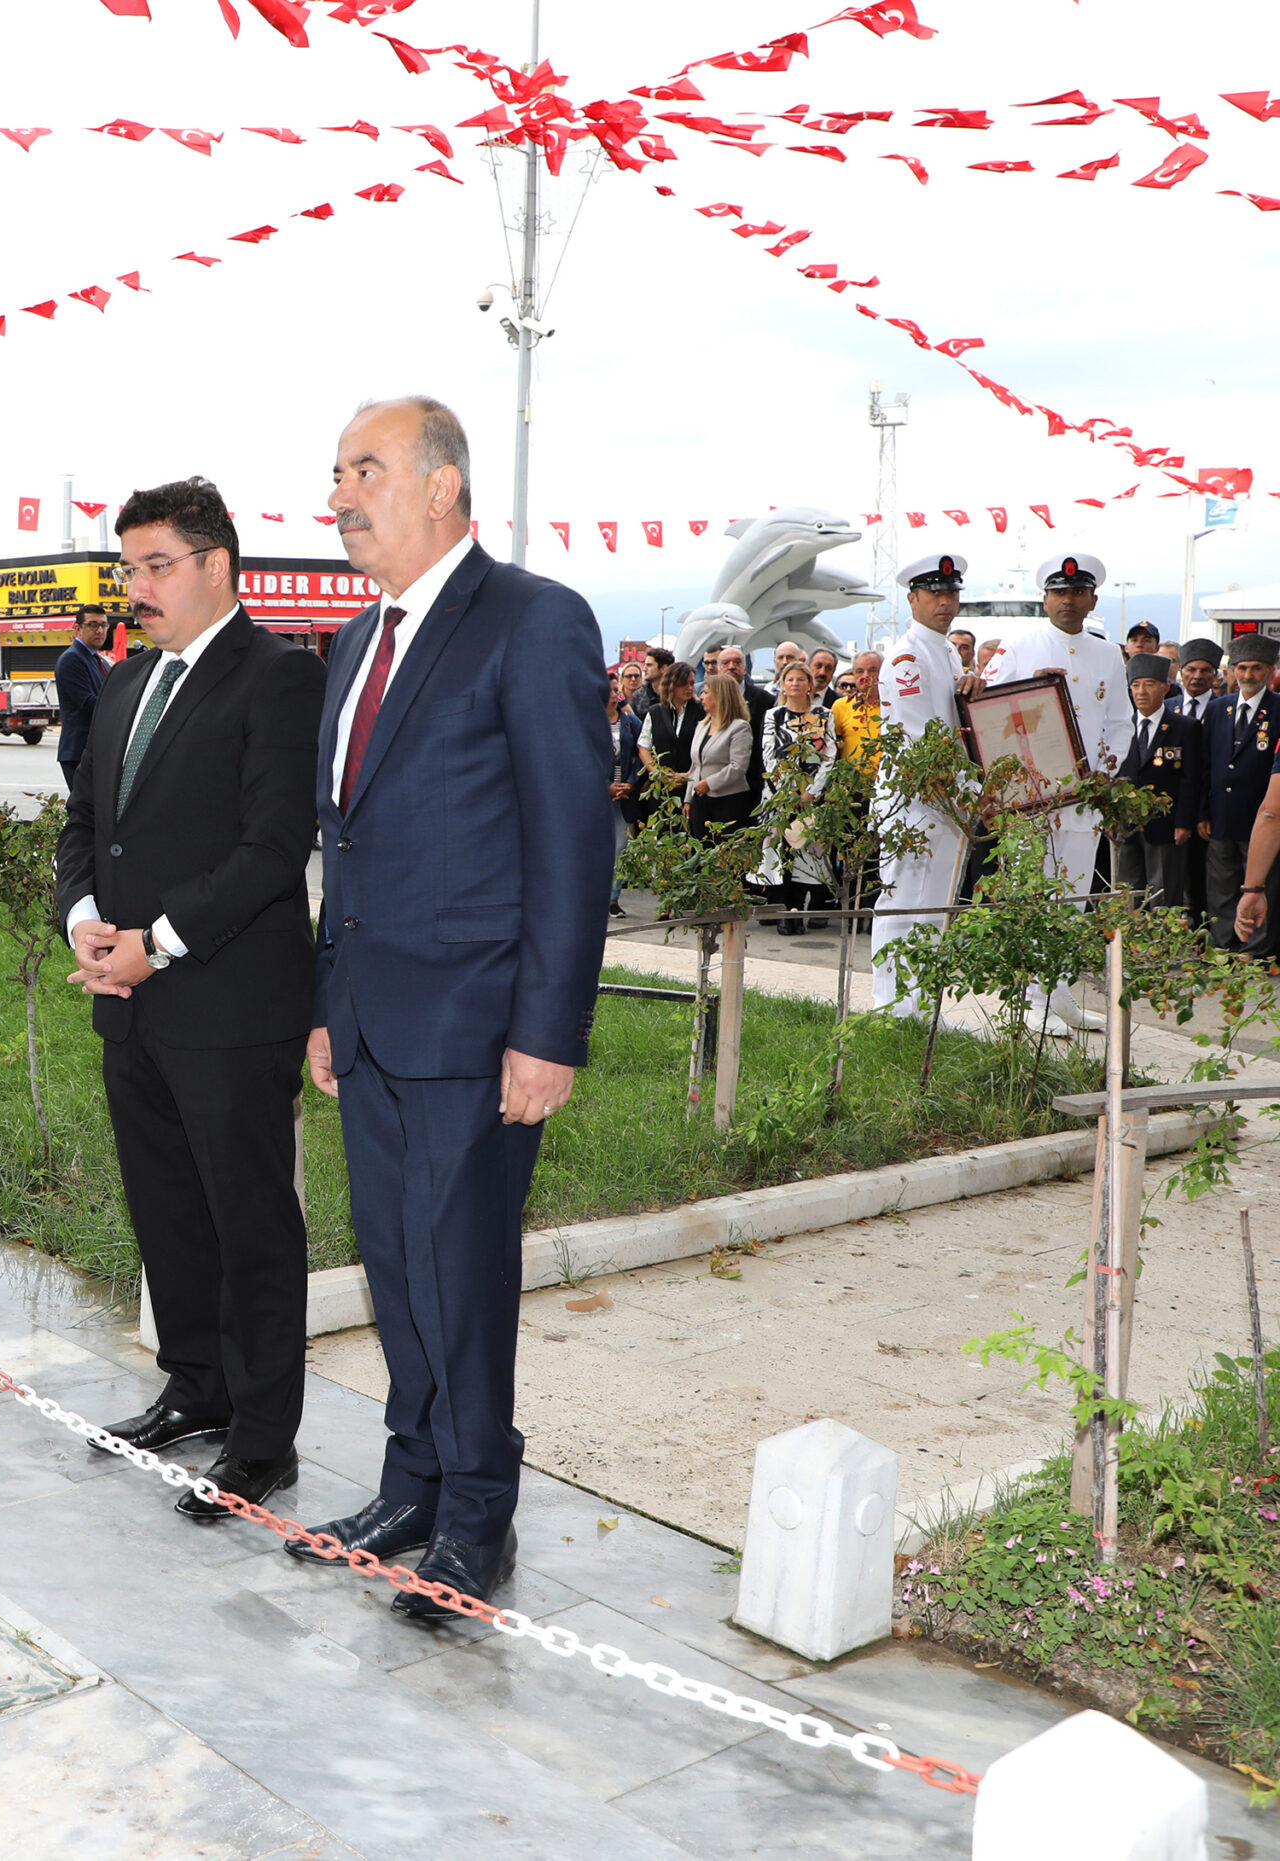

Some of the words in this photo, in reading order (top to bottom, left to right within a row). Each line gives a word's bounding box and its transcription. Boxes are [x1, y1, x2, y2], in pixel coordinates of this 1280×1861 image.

[18, 568, 57, 586] DOLMA
[99, 583, 127, 597] BAL
[320, 576, 382, 596] KOKO
[8, 589, 38, 604] BALIK
[40, 587, 78, 603] EKMEK
